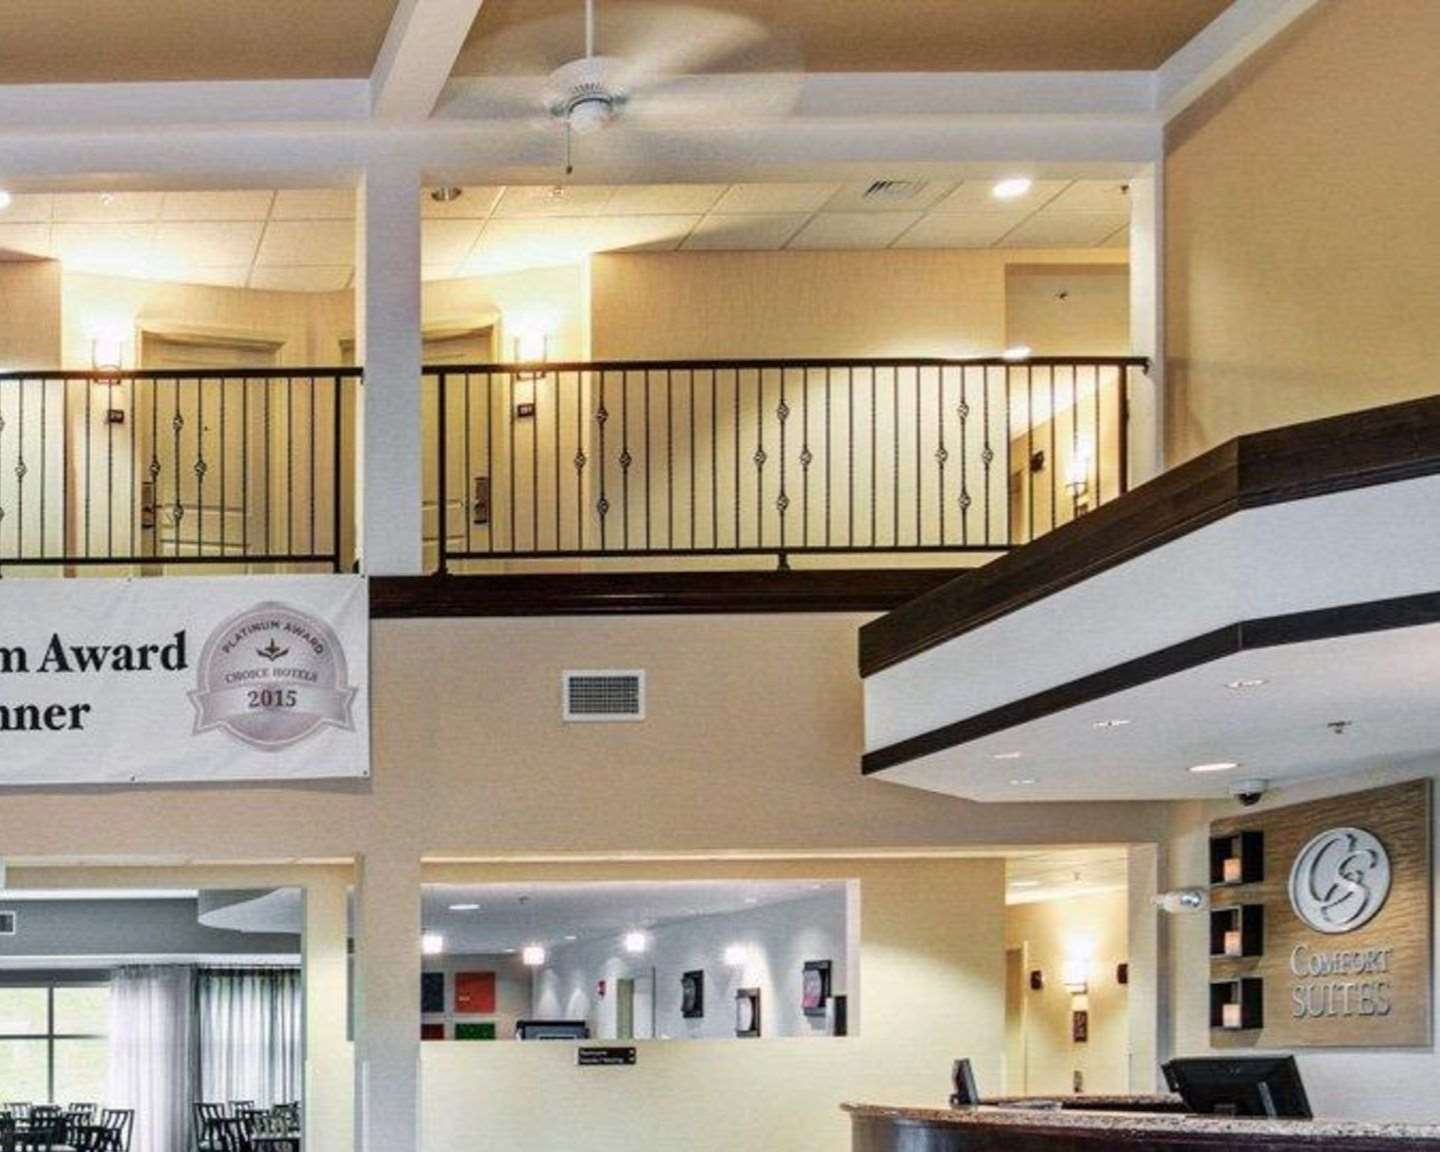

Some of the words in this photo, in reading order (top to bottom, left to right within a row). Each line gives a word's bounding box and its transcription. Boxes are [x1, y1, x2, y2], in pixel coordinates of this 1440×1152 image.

[37, 630, 189, 673] Award
[223, 620, 280, 654] PLATINUM
[283, 622, 324, 655] AWARD
[225, 668, 269, 684] CHOICE
[272, 667, 319, 683] HOTELS
[247, 689, 298, 708] 2015
[1292, 981, 1393, 1018] SUITES
